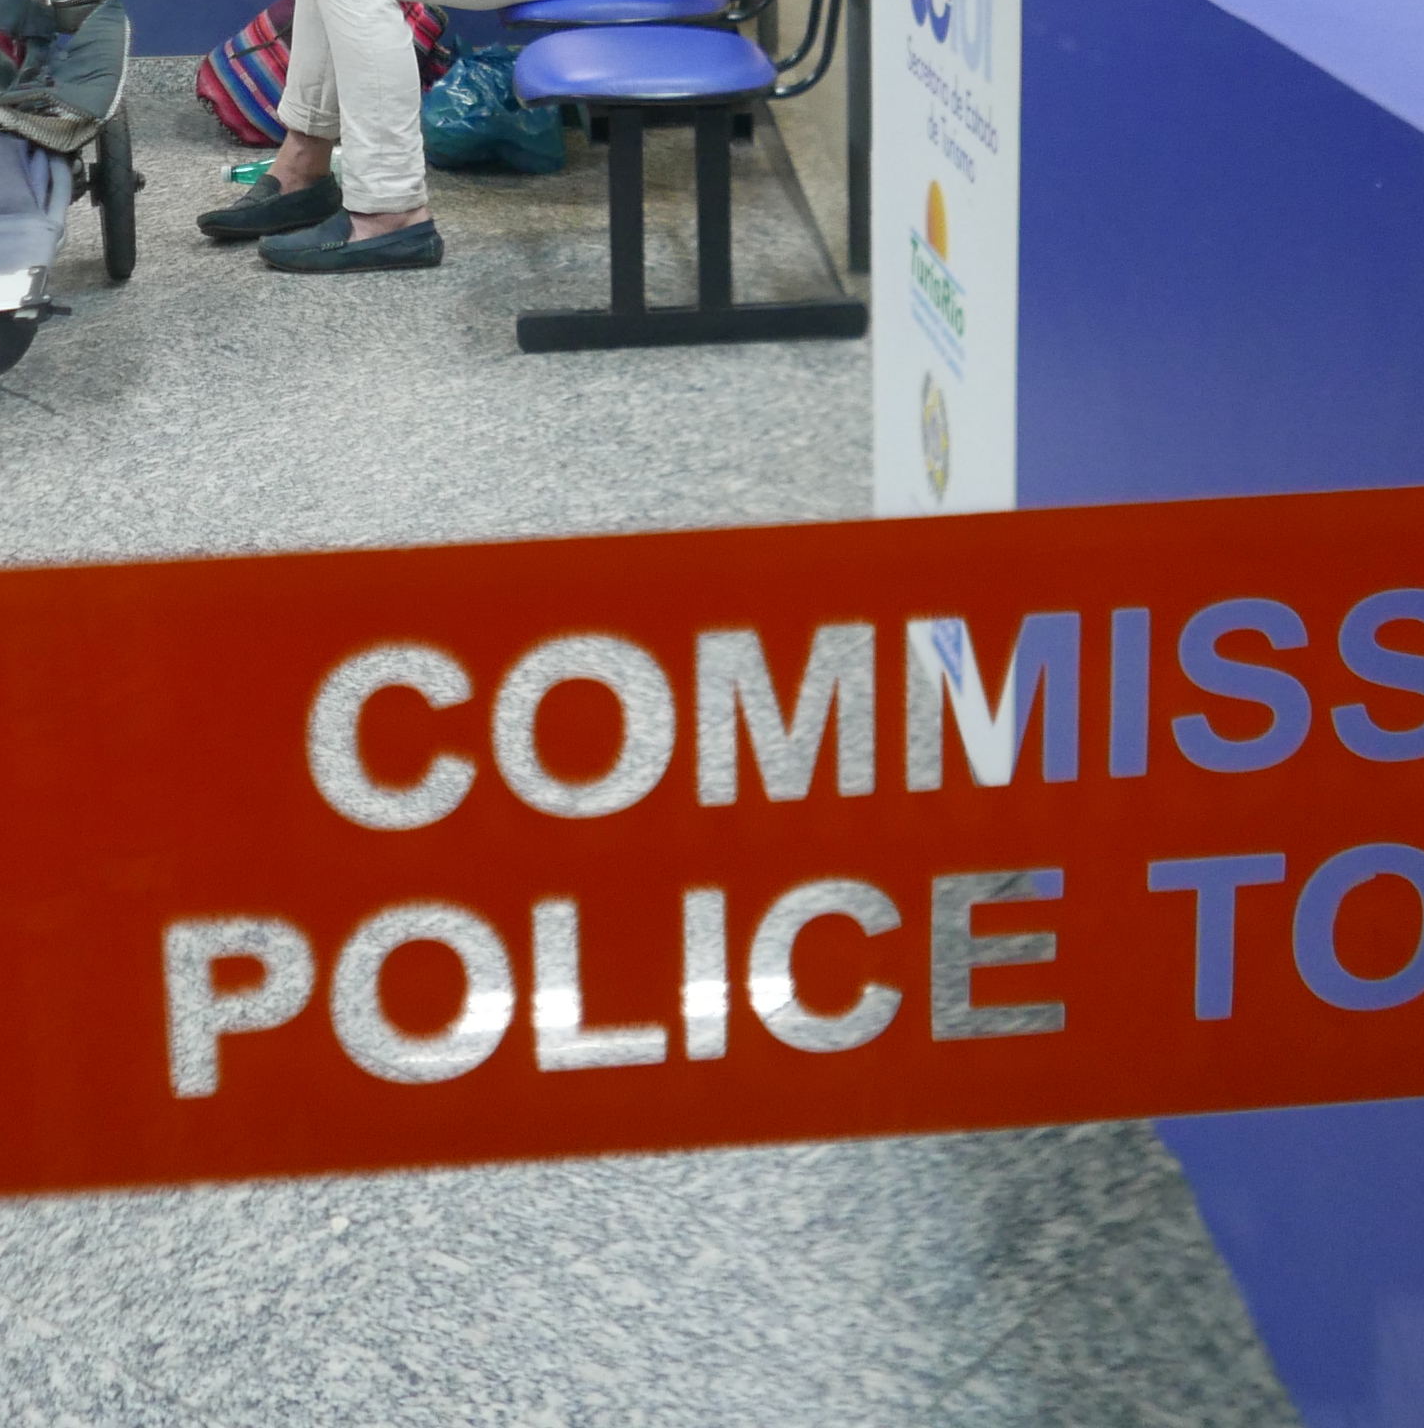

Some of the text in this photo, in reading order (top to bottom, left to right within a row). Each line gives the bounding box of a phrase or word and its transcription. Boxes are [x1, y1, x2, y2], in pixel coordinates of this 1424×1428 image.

[906, 34, 998, 155] Secretaria de Estado
[927, 102, 975, 183] de Turismo
[162, 868, 1066, 1098] POLICE
